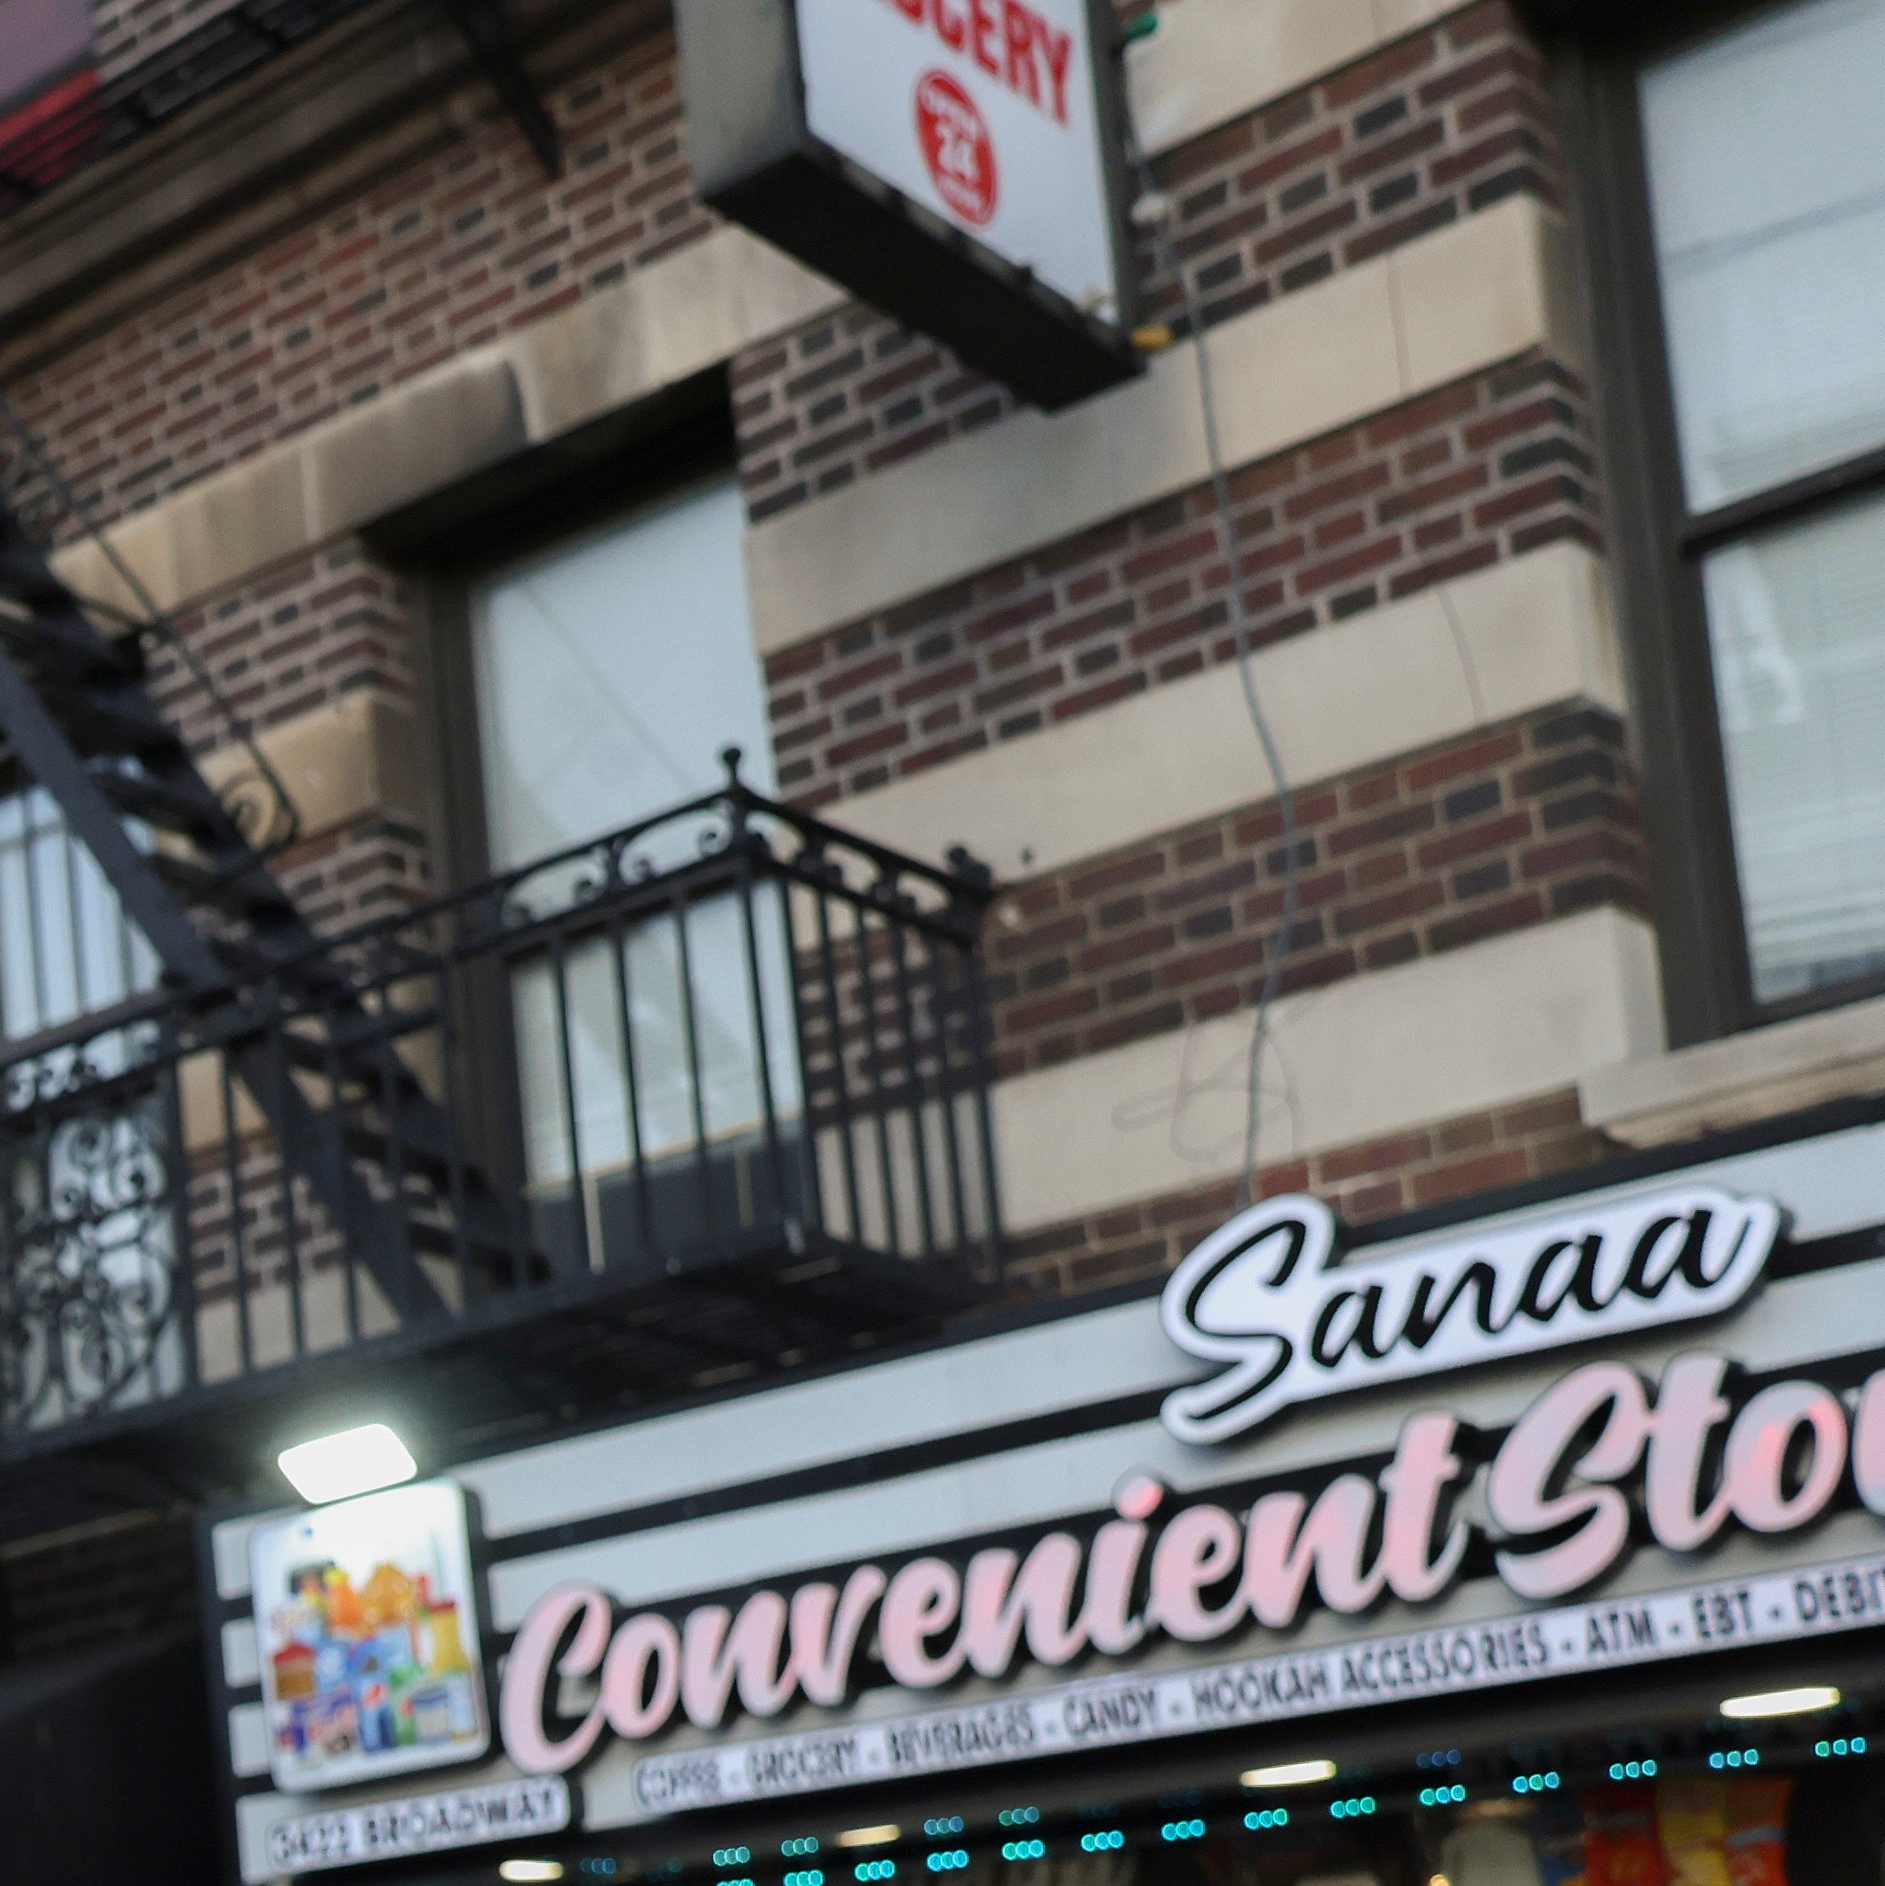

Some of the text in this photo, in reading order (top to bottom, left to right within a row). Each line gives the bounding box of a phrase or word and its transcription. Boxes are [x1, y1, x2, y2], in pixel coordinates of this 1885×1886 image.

[1185, 1208, 1756, 1421] Sanaa
[500, 1411, 1467, 1773] Convenient
[748, 1736, 858, 1788] GROCERY
[887, 1705, 1037, 1766] BEVERAGES
[1062, 1686, 1158, 1738] CANDY
[1192, 1664, 1329, 1713] HOOKAH
[1341, 1622, 1549, 1694] ACCESSORIES
[1586, 1607, 1656, 1655] ATM
[1691, 1588, 1755, 1640] EBT
[1793, 1567, 1885, 1623] DEBI
[365, 1786, 554, 1844] BROADWAY
